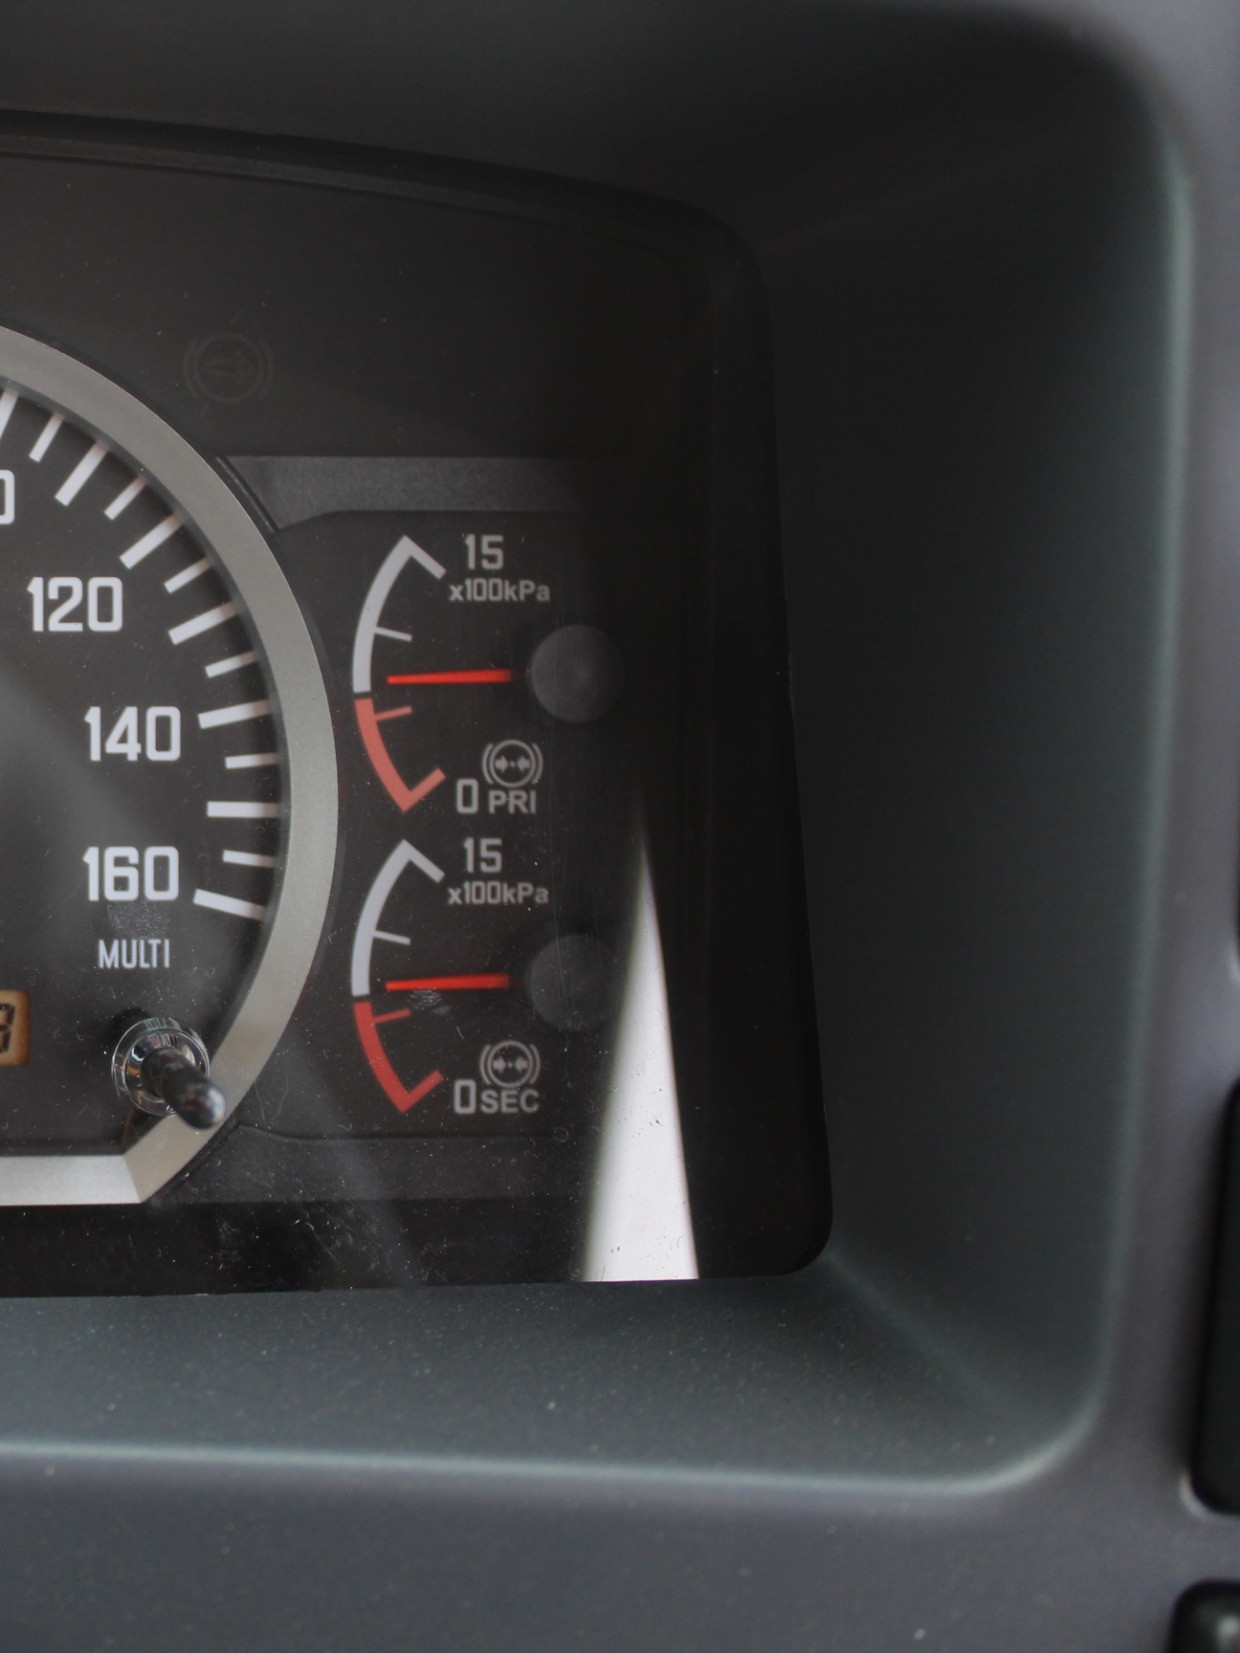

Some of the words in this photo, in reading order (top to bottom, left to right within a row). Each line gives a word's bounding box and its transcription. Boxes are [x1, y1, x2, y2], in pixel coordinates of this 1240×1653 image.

[464, 534, 504, 571] 15
[27, 576, 123, 632] 120
[449, 577, 551, 602] x100kPa
[84, 706, 181, 762] 140
[456, 778, 478, 814] 0
[488, 790, 536, 814] PRI
[463, 837, 502, 873] 15
[82, 846, 179, 902] 160
[447, 880, 548, 904] x100kPa
[98, 938, 170, 969] MULTI
[454, 1079, 476, 1114] 0
[481, 1089, 540, 1113] SEC
